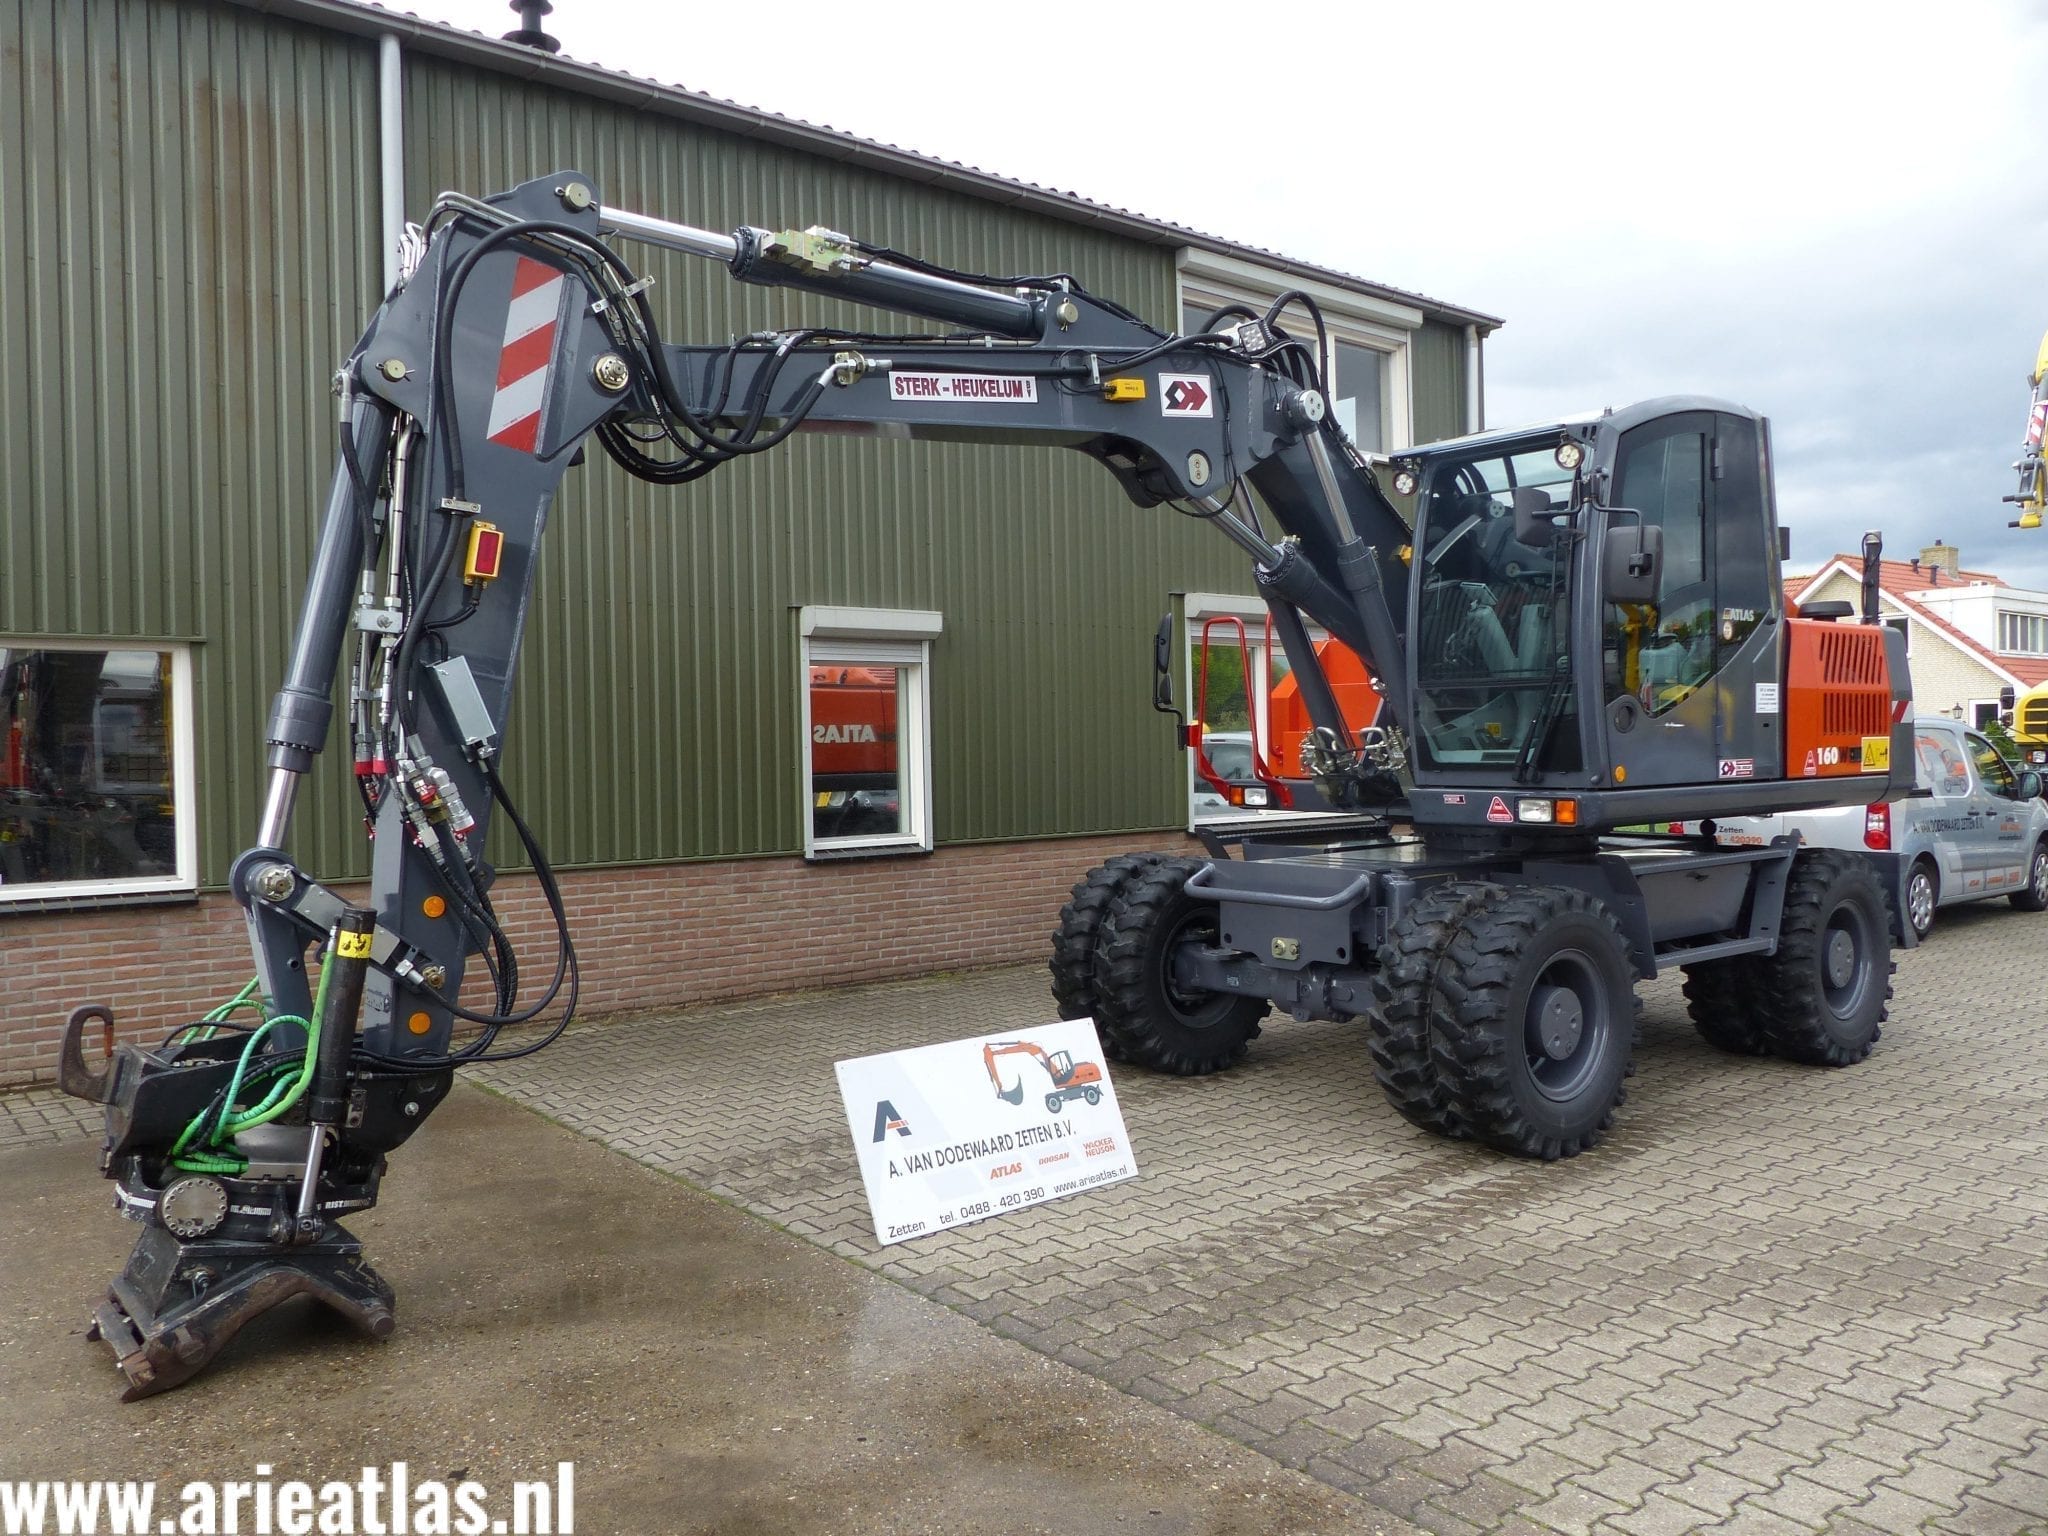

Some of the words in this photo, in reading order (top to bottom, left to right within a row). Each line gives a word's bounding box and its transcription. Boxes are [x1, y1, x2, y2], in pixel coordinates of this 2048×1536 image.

[895, 376, 941, 396] STERK
[952, 378, 1024, 398] HEUKELUM
[1730, 608, 1755, 622] ATLAS
[1718, 826, 1744, 834] Zetten
[889, 1160, 903, 1179] A.
[904, 1152, 934, 1174] VAN
[935, 1133, 1014, 1167] DODEWAARD
[1015, 1123, 1053, 1148] ZETTEN
[1054, 1119, 1076, 1139] B.V.
[1082, 1136, 1113, 1150] WACKER
[1085, 1144, 1116, 1158] NEUSON
[1038, 1151, 1070, 1166] DOOSAN
[990, 1162, 1023, 1180] ATLAS
[1053, 1164, 1128, 1194] www.arieatlas.nl
[887, 1220, 926, 1239] Zetten
[939, 1210, 958, 1225] tel.
[960, 1201, 991, 1219] 0488
[999, 1193, 1021, 1209] 420
[1023, 1187, 1045, 1202] 390
